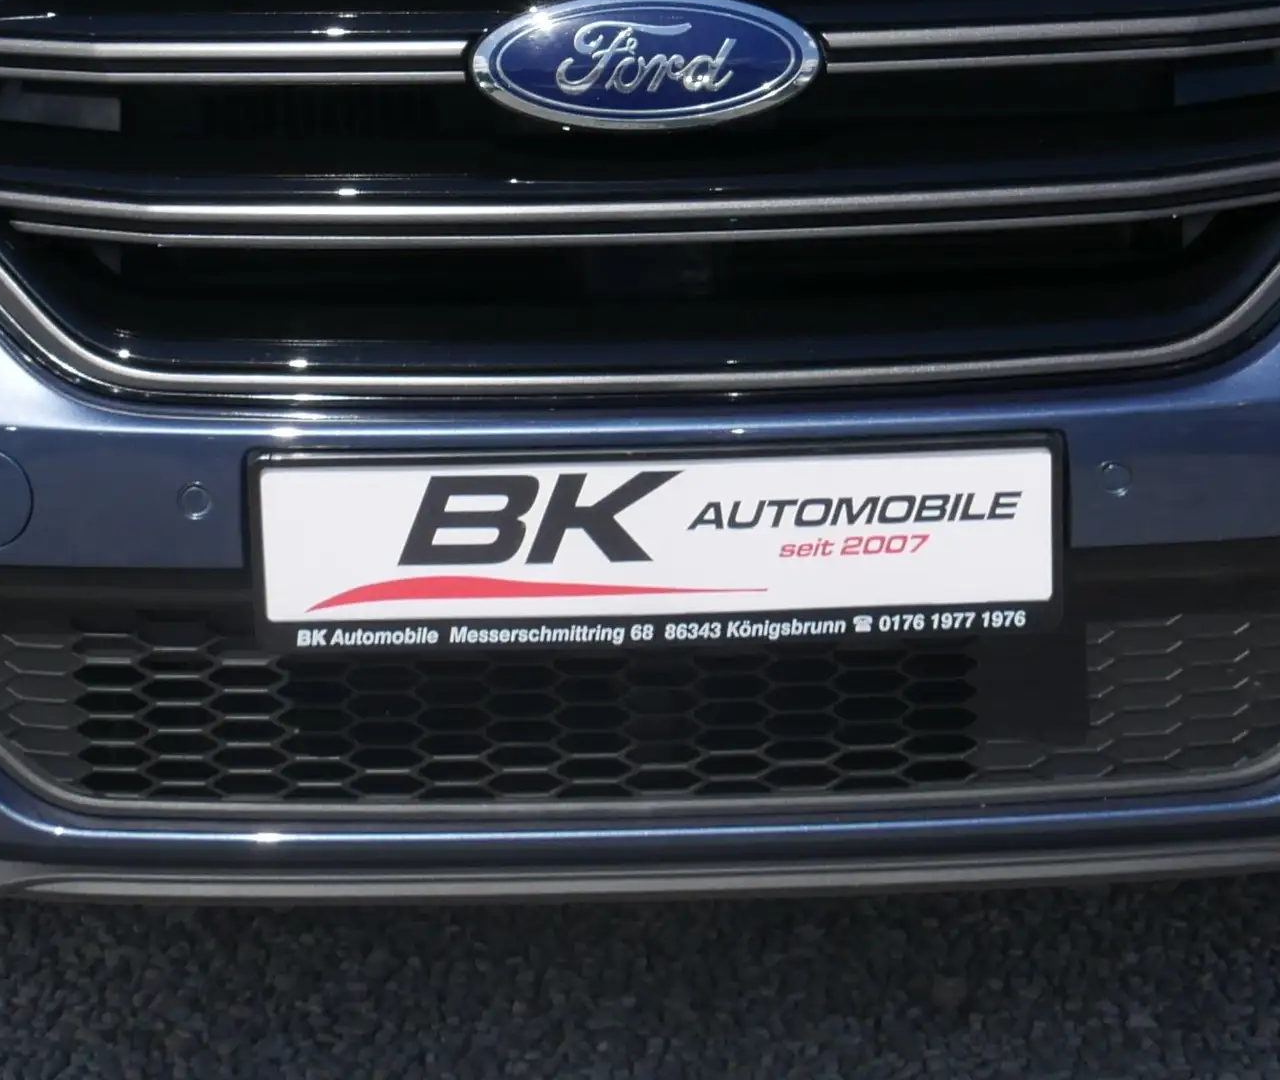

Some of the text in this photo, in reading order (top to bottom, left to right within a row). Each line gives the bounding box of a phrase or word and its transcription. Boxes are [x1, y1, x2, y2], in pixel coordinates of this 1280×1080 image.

[556, 21, 737, 95] Ford
[397, 469, 1023, 566] BK AUTOMOBILE
[779, 534, 930, 558] seit 2007
[297, 609, 1026, 647] BK Automobile Messerschmittring 68 86343 Königsbrunn 0176 1977 1976
